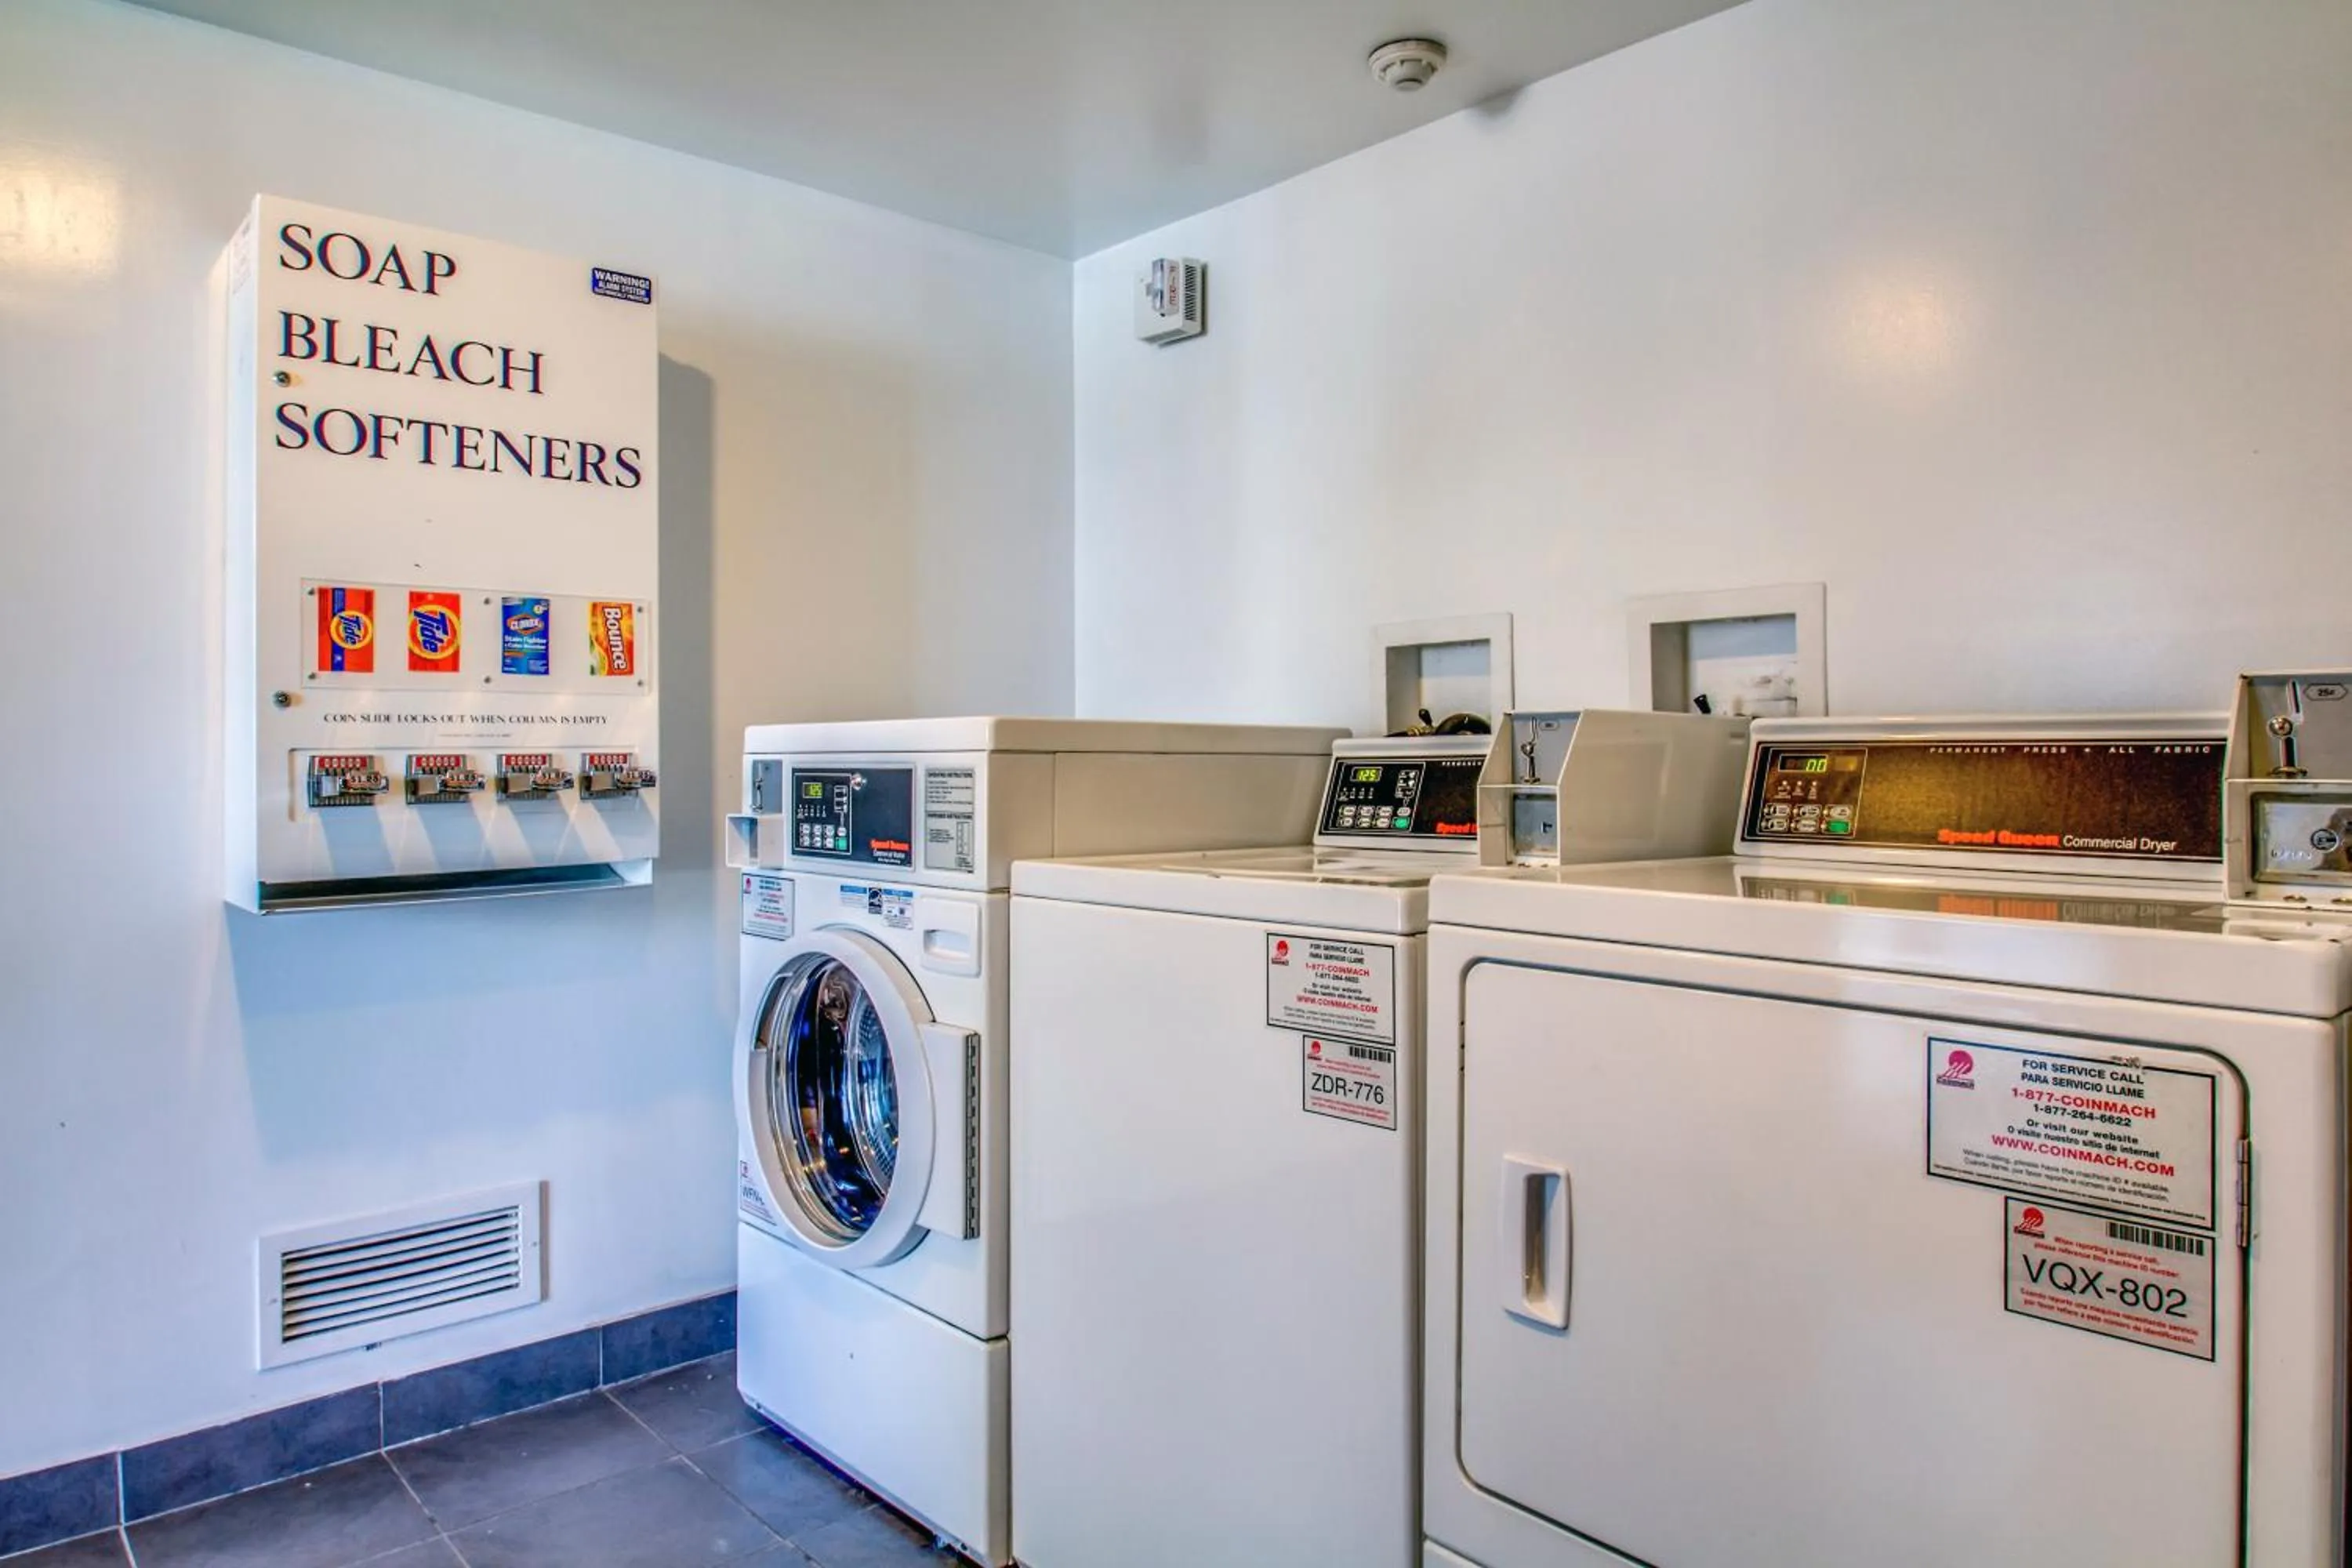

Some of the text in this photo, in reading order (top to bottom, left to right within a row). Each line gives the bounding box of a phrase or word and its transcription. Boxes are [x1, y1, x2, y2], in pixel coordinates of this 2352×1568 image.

[279, 223, 456, 295] SOAP
[593, 269, 650, 290] WARNING!
[621, 285, 646, 296] SYSTEM
[278, 310, 545, 394] BLEACH
[275, 402, 641, 488] SOFTENERS
[339, 615, 363, 645] Tide
[413, 609, 449, 653] Tide
[604, 608, 626, 670] Bounce
[324, 713, 608, 724] COIN SLIDE LOCKS OUT WHEN COLUMN IS EMPTY
[1436, 822, 1471, 835] Speed
[1938, 829, 2176, 853] Speed Queen Commercial Dryer
[1323, 945, 1347, 953] SERVICE
[1348, 946, 1364, 955] CALL
[1305, 962, 1370, 976] 1-877-COINMACH
[1296, 994, 1378, 1014] WWW.COINMACH.COM
[2022, 1058, 2144, 1084] FOR SERVICE CALL
[1311, 1072, 1384, 1105] ZDR-776
[2021, 1072, 2144, 1098] PARA SERVICIO LLAME
[2011, 1087, 2156, 1119] 1-877-COINMACH
[2033, 1103, 2132, 1127] 1-877-264-6622
[2007, 1125, 2014, 1134] O
[2017, 1129, 2041, 1138] visite
[2044, 1133, 2079, 1145] nuestro
[2082, 1139, 2103, 1149] sitio
[2120, 1145, 2160, 1159] internet
[2027, 1119, 2039, 1127] Or
[2043, 1122, 2067, 1132] visit
[2093, 1131, 2139, 1144] website
[1991, 1134, 2174, 1177] WWW.COINMACH.COM
[2022, 1254, 2187, 1318] VQX-802
